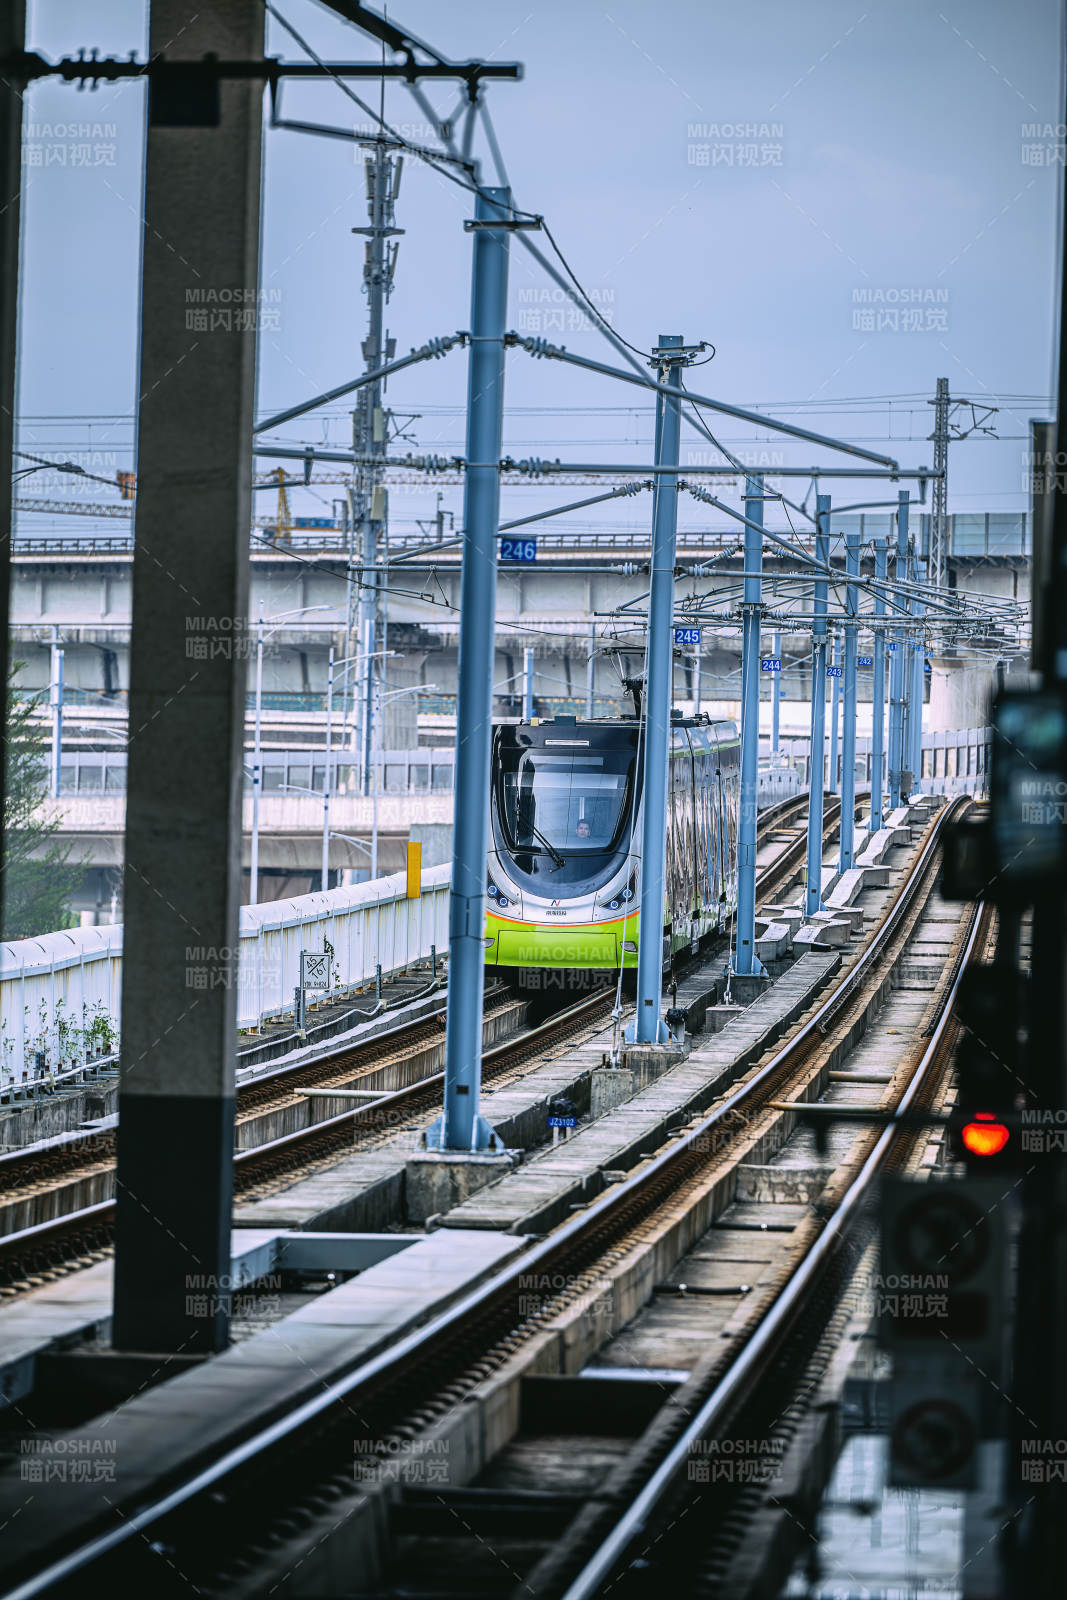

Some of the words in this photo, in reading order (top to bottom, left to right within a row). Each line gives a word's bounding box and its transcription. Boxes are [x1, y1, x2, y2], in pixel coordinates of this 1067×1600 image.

[502, 542, 535, 560] 246
[676, 630, 699, 643] 245
[762, 661, 780, 671] 244
[859, 657, 872, 665] 242
[827, 668, 842, 677] 243
[306, 956, 317, 969] 45
[311, 963, 327, 979] 167
